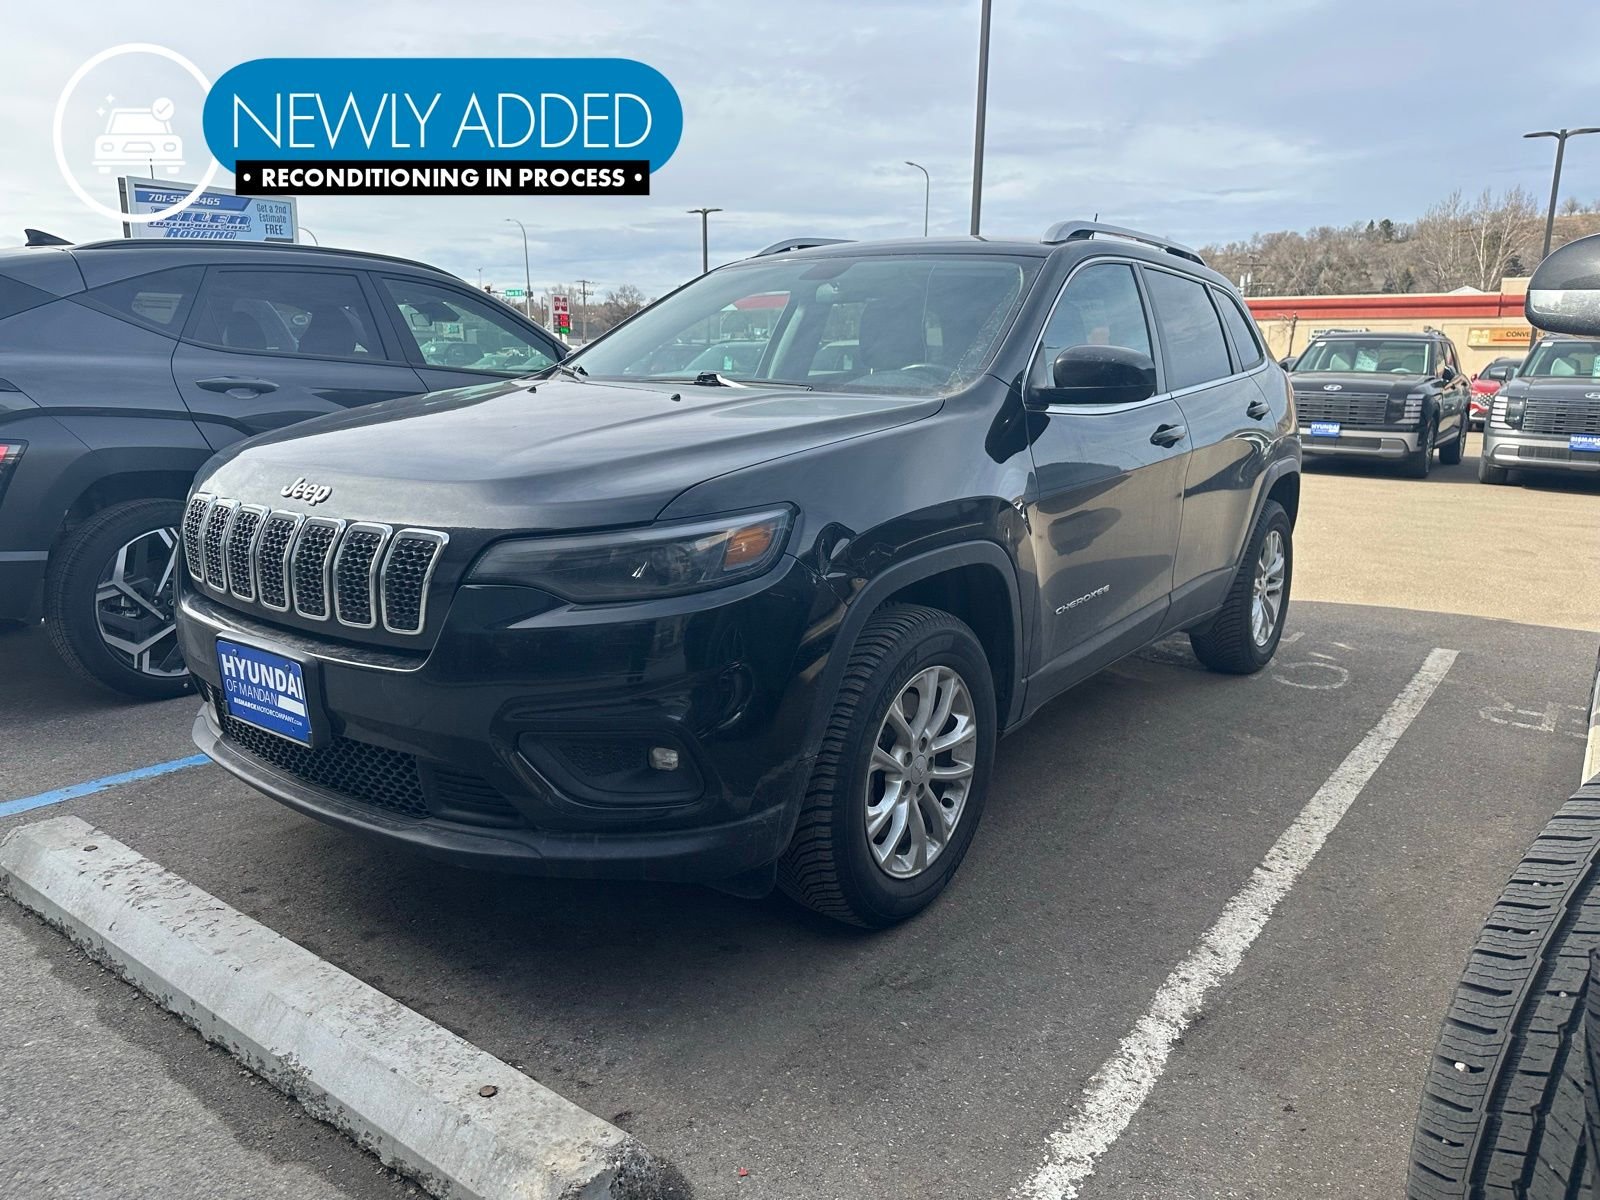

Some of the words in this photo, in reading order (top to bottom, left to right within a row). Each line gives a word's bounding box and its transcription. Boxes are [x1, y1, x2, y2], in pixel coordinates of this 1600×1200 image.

[148, 193, 221, 206] 701-522465
[257, 203, 267, 213] Get
[276, 205, 287, 214] 2nd
[259, 214, 287, 224] Estimate
[165, 227, 236, 240] ROOFING
[265, 224, 283, 235] FREE
[280, 477, 332, 506] Jeep
[1055, 584, 1110, 615] CHEROKEE
[221, 654, 304, 700] HYUNDAI
[226, 678, 238, 693] OF
[239, 682, 278, 707] MANDAN
